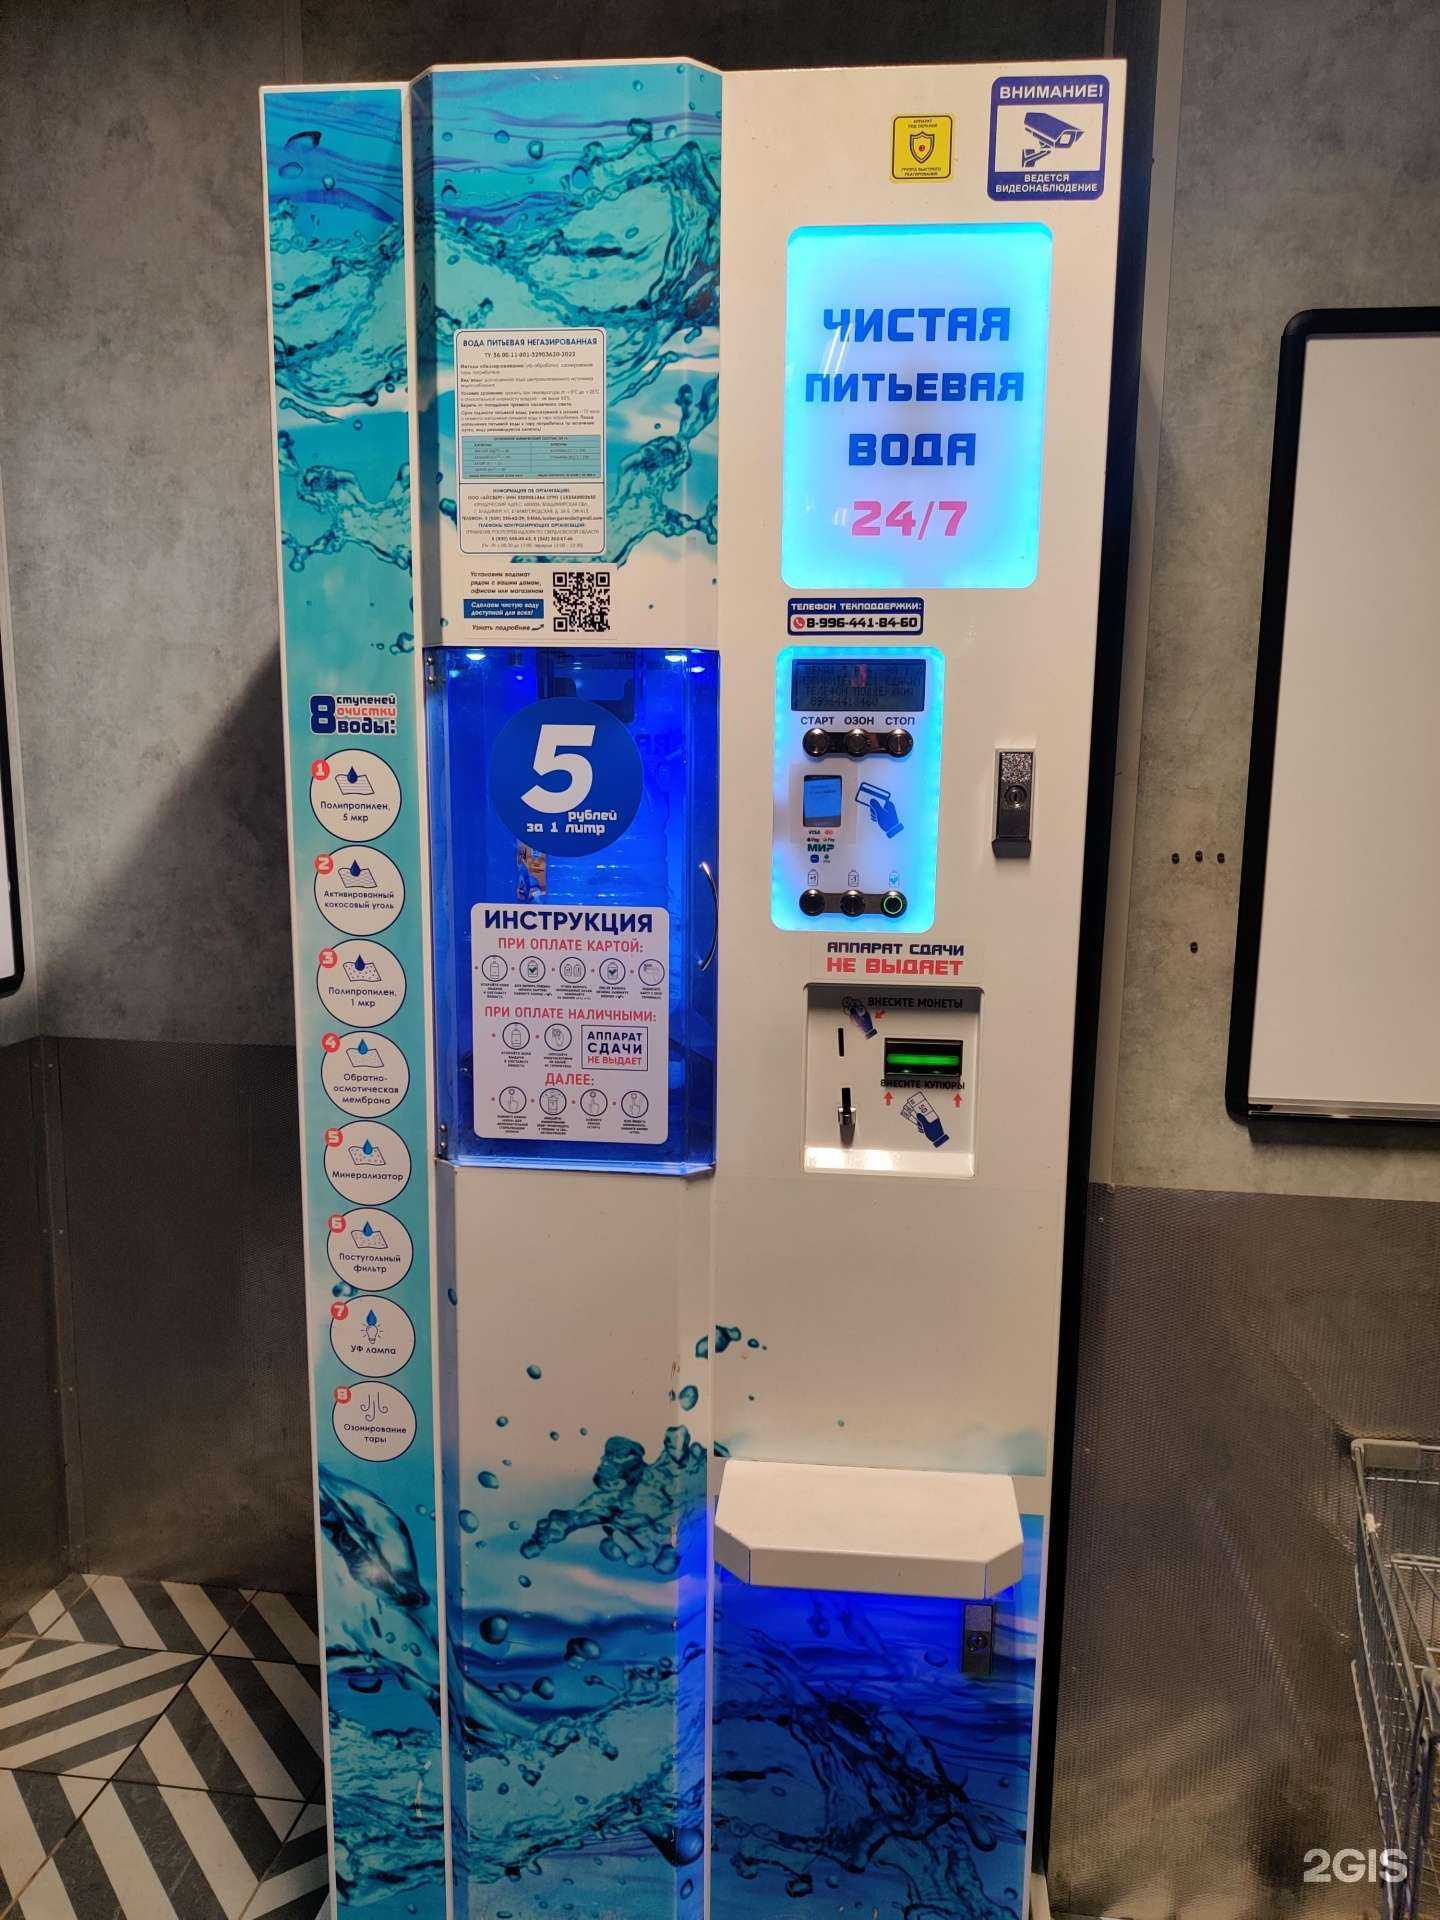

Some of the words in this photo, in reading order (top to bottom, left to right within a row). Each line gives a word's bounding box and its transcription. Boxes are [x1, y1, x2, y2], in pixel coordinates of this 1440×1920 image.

[1000, 85, 1103, 99] ВНИМАНИЕ!
[1024, 174, 1069, 183] ВЕДЕТСЯ
[996, 184, 1097, 193] ВИДЕОНАБЛЮДЕНИЕ
[823, 308, 1010, 342] ЧИСТАЯ
[463, 339, 485, 347] ВОДА
[487, 339, 525, 347] ПИТЬЕВАЯ
[527, 338, 598, 346] НЕГАЗИРОВАННАЯ
[805, 372, 1024, 401] ПИТЬЕВАЯ
[849, 433, 976, 466] ВОДА
[852, 501, 967, 540] 24/7
[807, 617, 917, 628] 8-996-441-84-60
[337, 695, 395, 706] ступеней
[310, 696, 336, 733] 8
[337, 707, 395, 716] очистки
[338, 718, 395, 733] воды:
[800, 716, 835, 725] СТАРТ
[844, 716, 874, 725] ОЗОН
[885, 717, 915, 725] СТОП
[316, 763, 324, 776] 1
[521, 724, 596, 813] 5
[321, 801, 390, 811] Полипропилен,
[568, 809, 617, 822] рублей
[527, 823, 543, 832] за
[550, 822, 558, 832] 1
[565, 823, 605, 835] литр
[808, 844, 834, 852] МИР
[319, 857, 330, 871] 2
[324, 890, 394, 899] Активированный
[325, 901, 370, 909] кокосовый
[485, 910, 652, 935] ИНСТРУКЦИЯ
[498, 937, 525, 950] ПРИ
[530, 939, 582, 951] ОПЛАТЕ
[587, 939, 643, 952] КАРТОЙ:
[827, 942, 903, 954] АППАРАТ
[909, 944, 964, 956] СДАЧИ
[323, 952, 333, 965] 3
[827, 957, 856, 972] НЕ
[866, 958, 963, 975] ВЫДАЕТ
[329, 987, 397, 997] Полипропилен,
[358, 1000, 376, 1008] мкр
[868, 997, 915, 1008] ВНЕСИТЕ
[918, 998, 963, 1008] МОНЕТЫ
[485, 1006, 510, 1017] ПРИ
[515, 1007, 564, 1019] ОПЛАТЕ
[568, 1009, 656, 1021] НАЛИЧНЫМИ:
[325, 1036, 336, 1048] 4
[587, 1031, 642, 1042] АППАРАТ
[587, 1043, 642, 1055] СДАЧИ
[587, 1056, 601, 1065] НЕ
[603, 1057, 642, 1066] ВЫДАЕТ
[343, 1073, 387, 1082] Обратно-
[545, 1073, 594, 1086] ДАЛЕЕ:
[334, 1085, 399, 1094] осмотическая
[880, 1079, 921, 1089] ВНЕСИТЕ
[924, 1080, 965, 1090] КУПЮРЫ
[342, 1095, 390, 1105] мембрана
[328, 1131, 339, 1143] 5
[332, 1170, 403, 1181] Минерализатор
[339, 1252, 401, 1263] Постугольный
[353, 1264, 387, 1274] фильтр
[335, 1306, 344, 1317] 7
[350, 1344, 364, 1353] УФ
[365, 1346, 396, 1356] лампа
[337, 1389, 348, 1400] 8
[343, 1423, 407, 1434] Озонирование
[364, 1436, 387, 1444] тары
